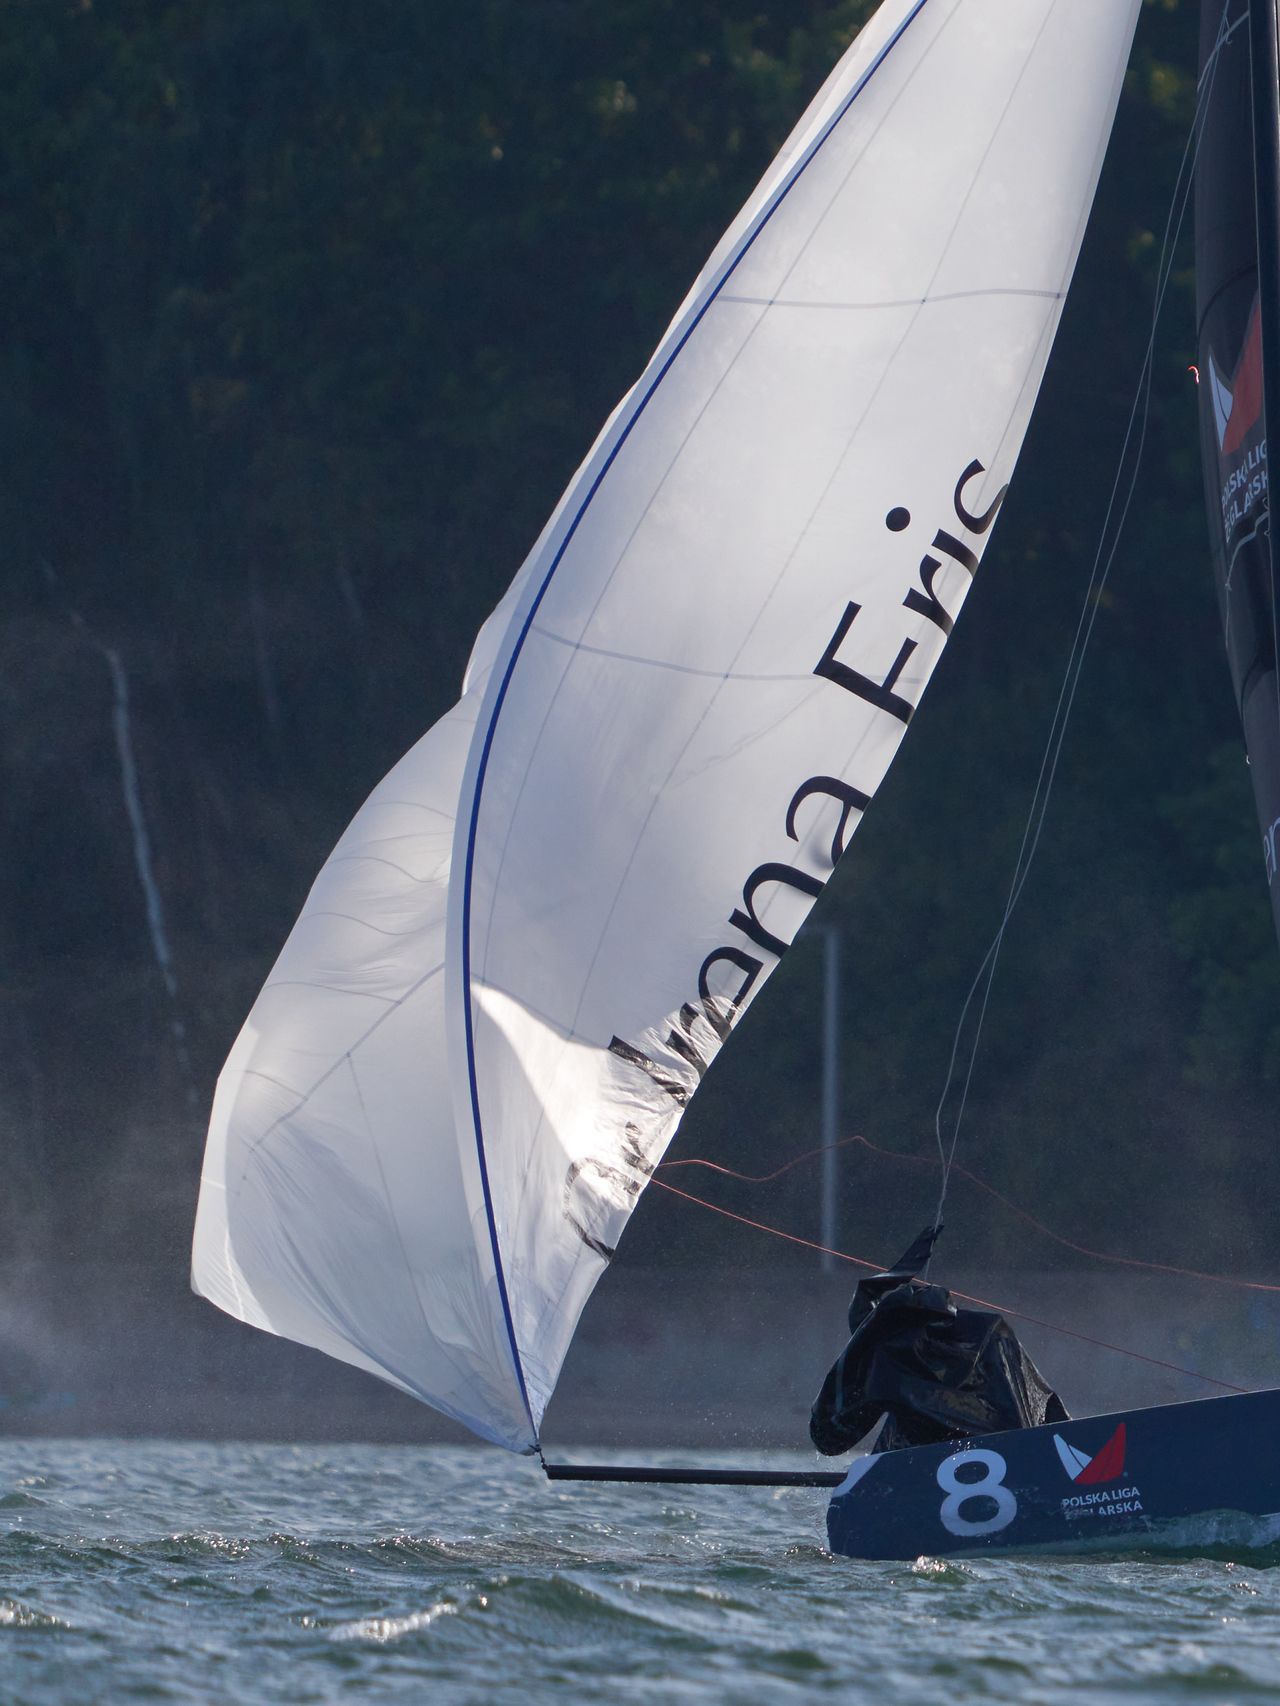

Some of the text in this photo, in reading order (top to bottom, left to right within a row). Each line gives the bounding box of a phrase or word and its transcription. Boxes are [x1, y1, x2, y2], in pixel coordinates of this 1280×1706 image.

[1248, 439, 1268, 471] LIG
[936, 1448, 1018, 1537] 8
[1061, 1486, 1141, 1507] POLSKA LIGA
